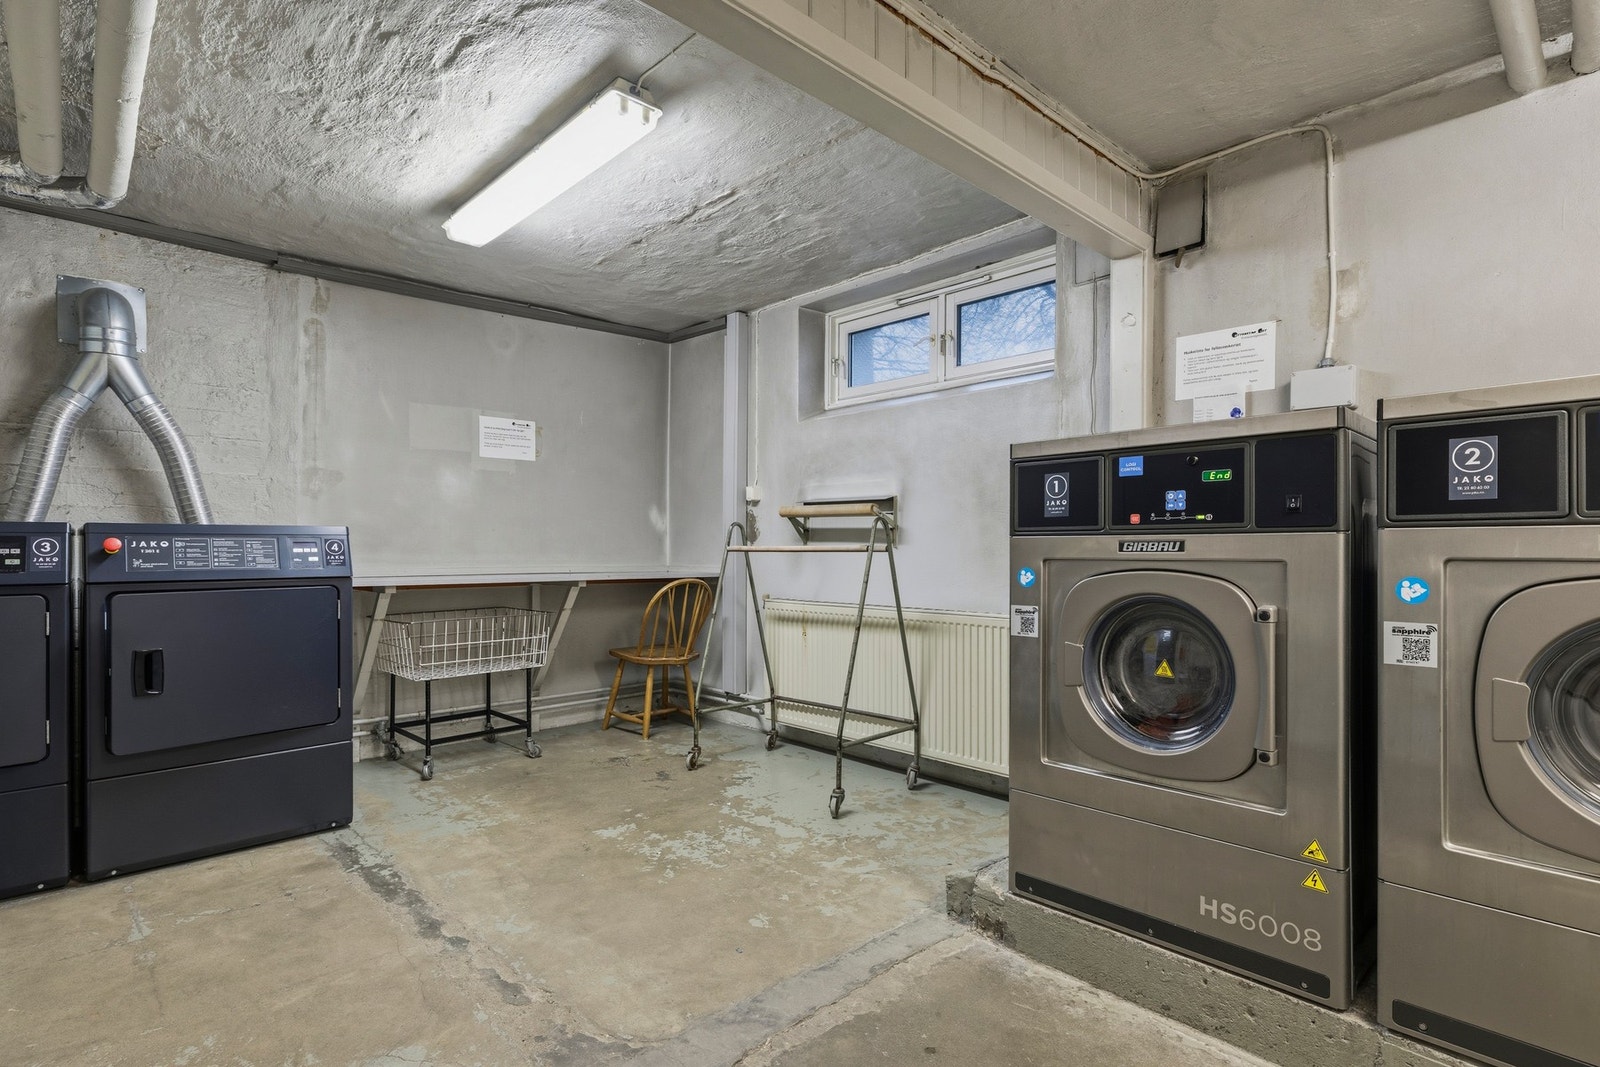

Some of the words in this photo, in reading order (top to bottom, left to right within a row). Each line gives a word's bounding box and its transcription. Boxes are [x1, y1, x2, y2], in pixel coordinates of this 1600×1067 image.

[1464, 447, 1480, 466] 2
[1210, 471, 1230, 480] End
[1452, 474, 1494, 484] JAKO
[1053, 480, 1058, 493] 1
[40, 542, 51, 552] 3
[330, 543, 338, 551] 4
[1122, 542, 1180, 552] GIRBAU
[1199, 895, 1322, 952] HS6008
